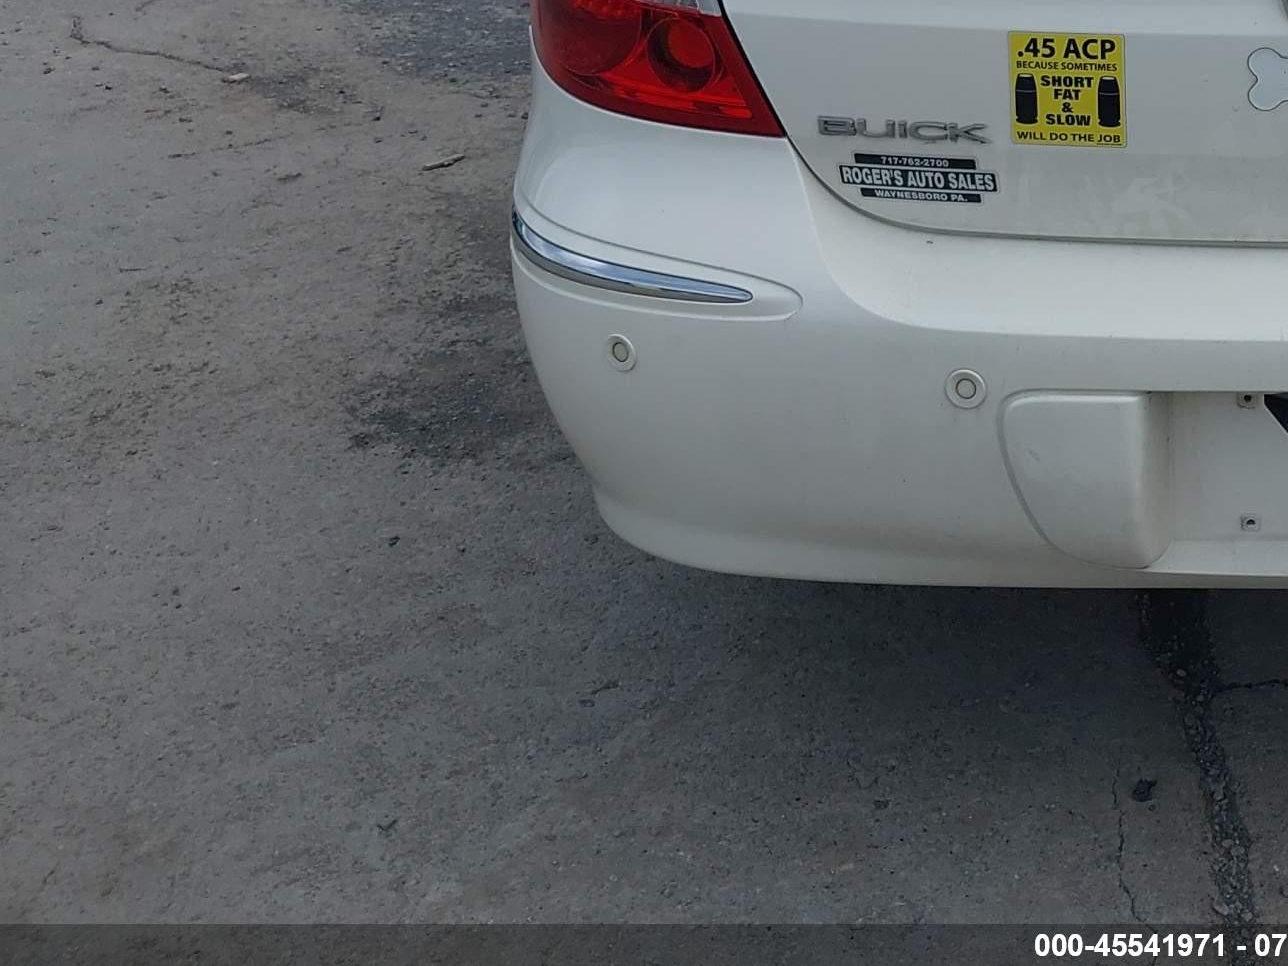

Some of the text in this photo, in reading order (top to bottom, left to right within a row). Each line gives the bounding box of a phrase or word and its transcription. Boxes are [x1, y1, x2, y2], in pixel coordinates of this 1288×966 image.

[1018, 38, 1116, 60] .45 ACP
[1016, 60, 1117, 72] BECAUSE SOMETIMES
[1040, 75, 1094, 88] SHORT
[1053, 89, 1081, 100] FAT
[1061, 102, 1074, 113] &
[1045, 113, 1091, 126] SLOW
[817, 115, 992, 144] BUICK
[1016, 131, 1121, 143] WILL DO THE JOB
[841, 166, 995, 191] ROGER'S AUTO SALES
[874, 189, 968, 202] WAYNESBORO PA.
